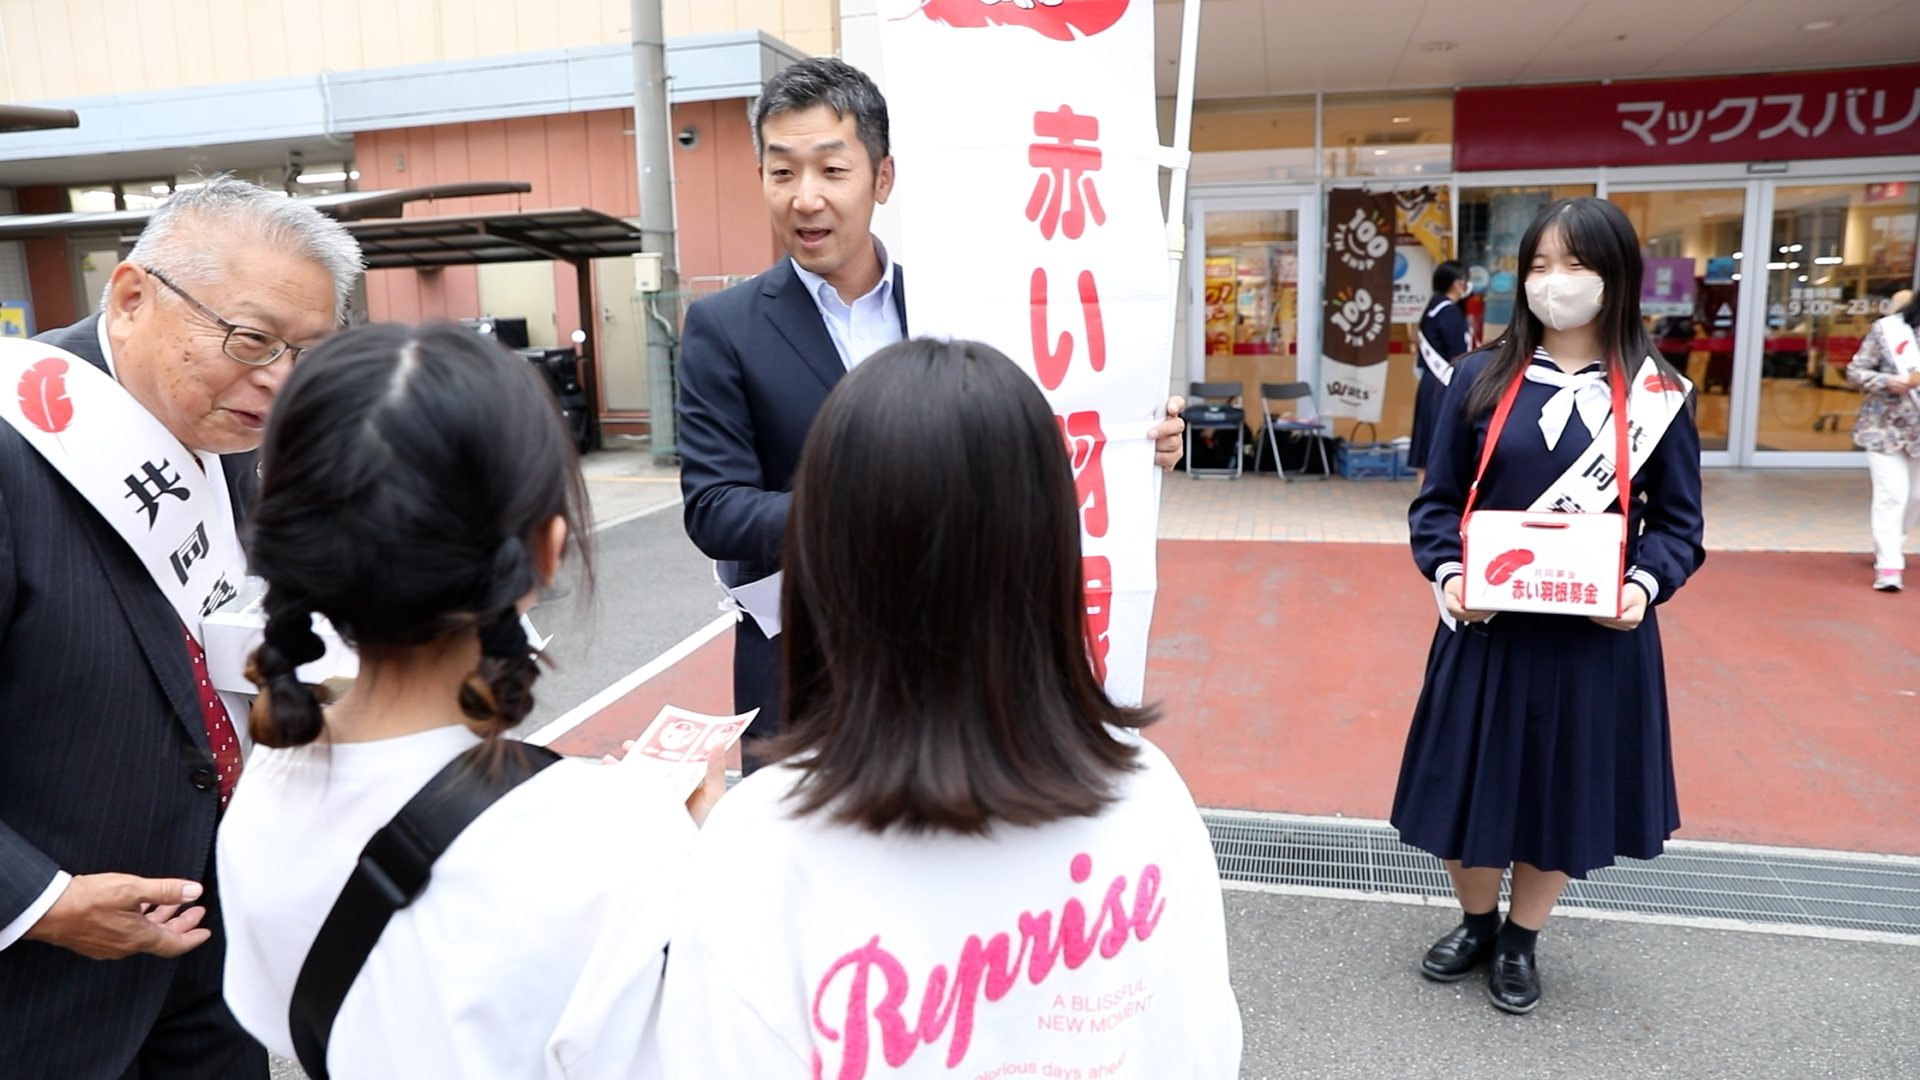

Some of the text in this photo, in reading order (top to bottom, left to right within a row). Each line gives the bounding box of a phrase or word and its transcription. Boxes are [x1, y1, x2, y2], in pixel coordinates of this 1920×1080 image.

[1616, 87, 1920, 146] マックスバリ
[1349, 208, 1389, 258] 100
[1330, 288, 1372, 332] 100
[1512, 580, 1599, 605] 赤い羽根募金
[812, 853, 1166, 1080] Reprise
[1052, 978, 1147, 1012] A BLISSFUL
[1038, 1015, 1085, 1033] NEW
[1042, 1061, 1083, 1080] days
